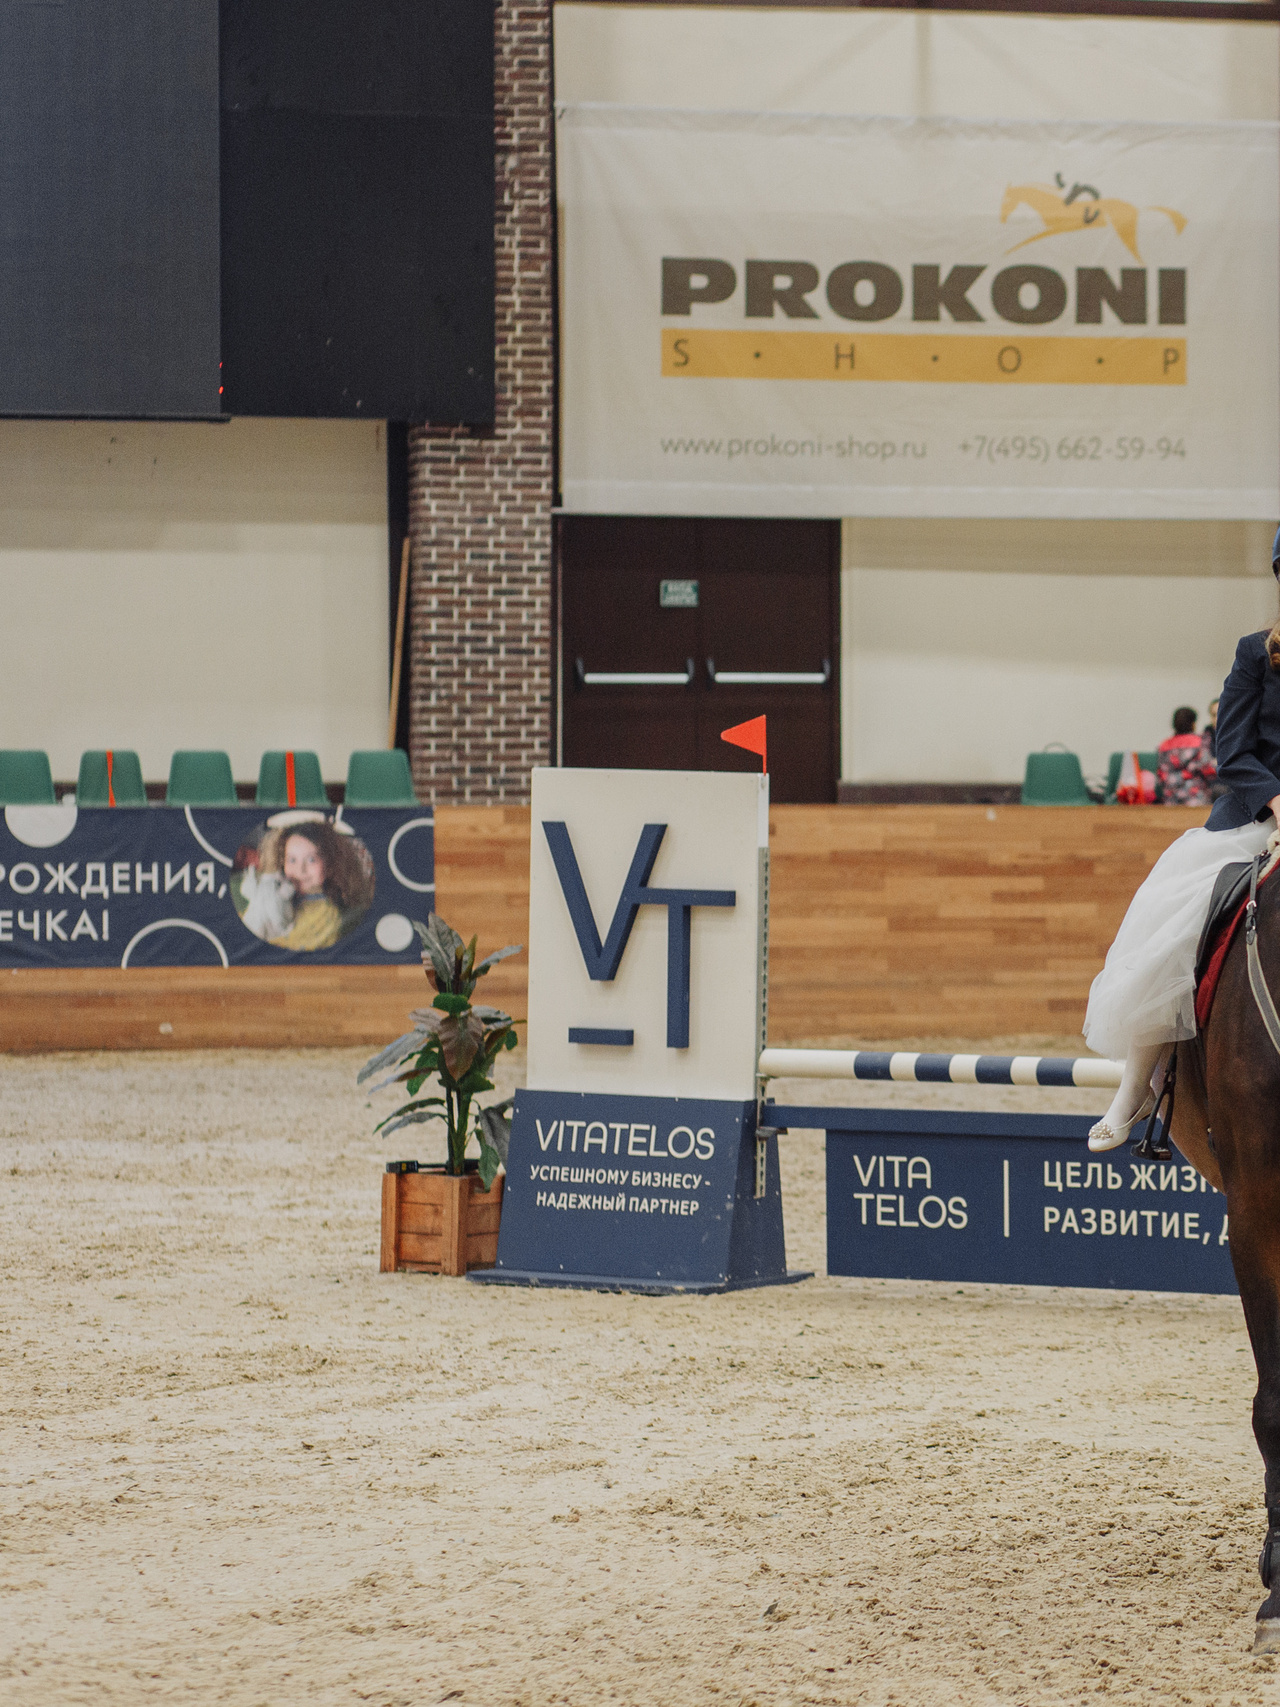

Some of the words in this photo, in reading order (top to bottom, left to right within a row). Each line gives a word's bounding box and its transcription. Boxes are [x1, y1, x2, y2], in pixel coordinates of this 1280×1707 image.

[660, 257, 1187, 325] PROKONI
[660, 434, 927, 462] www.prokoni-shop.ru
[959, 435, 1049, 463] +7(495)
[1056, 436, 1186, 461] 662-59-94
[535, 1119, 716, 1160] VITATELOS
[530, 1164, 630, 1186] УСПЕШНОМУ
[631, 1171, 703, 1190] БИЗНЕСУ
[853, 1154, 932, 1189] VITA
[1043, 1160, 1123, 1193] ЦЕЛЬ
[536, 1191, 627, 1212] НАДЕЖНЫЙ
[628, 1197, 700, 1216] ПАРТНЕР
[853, 1192, 968, 1230] TELOS
[1044, 1206, 1211, 1246] РАЗВИТИЕ,
